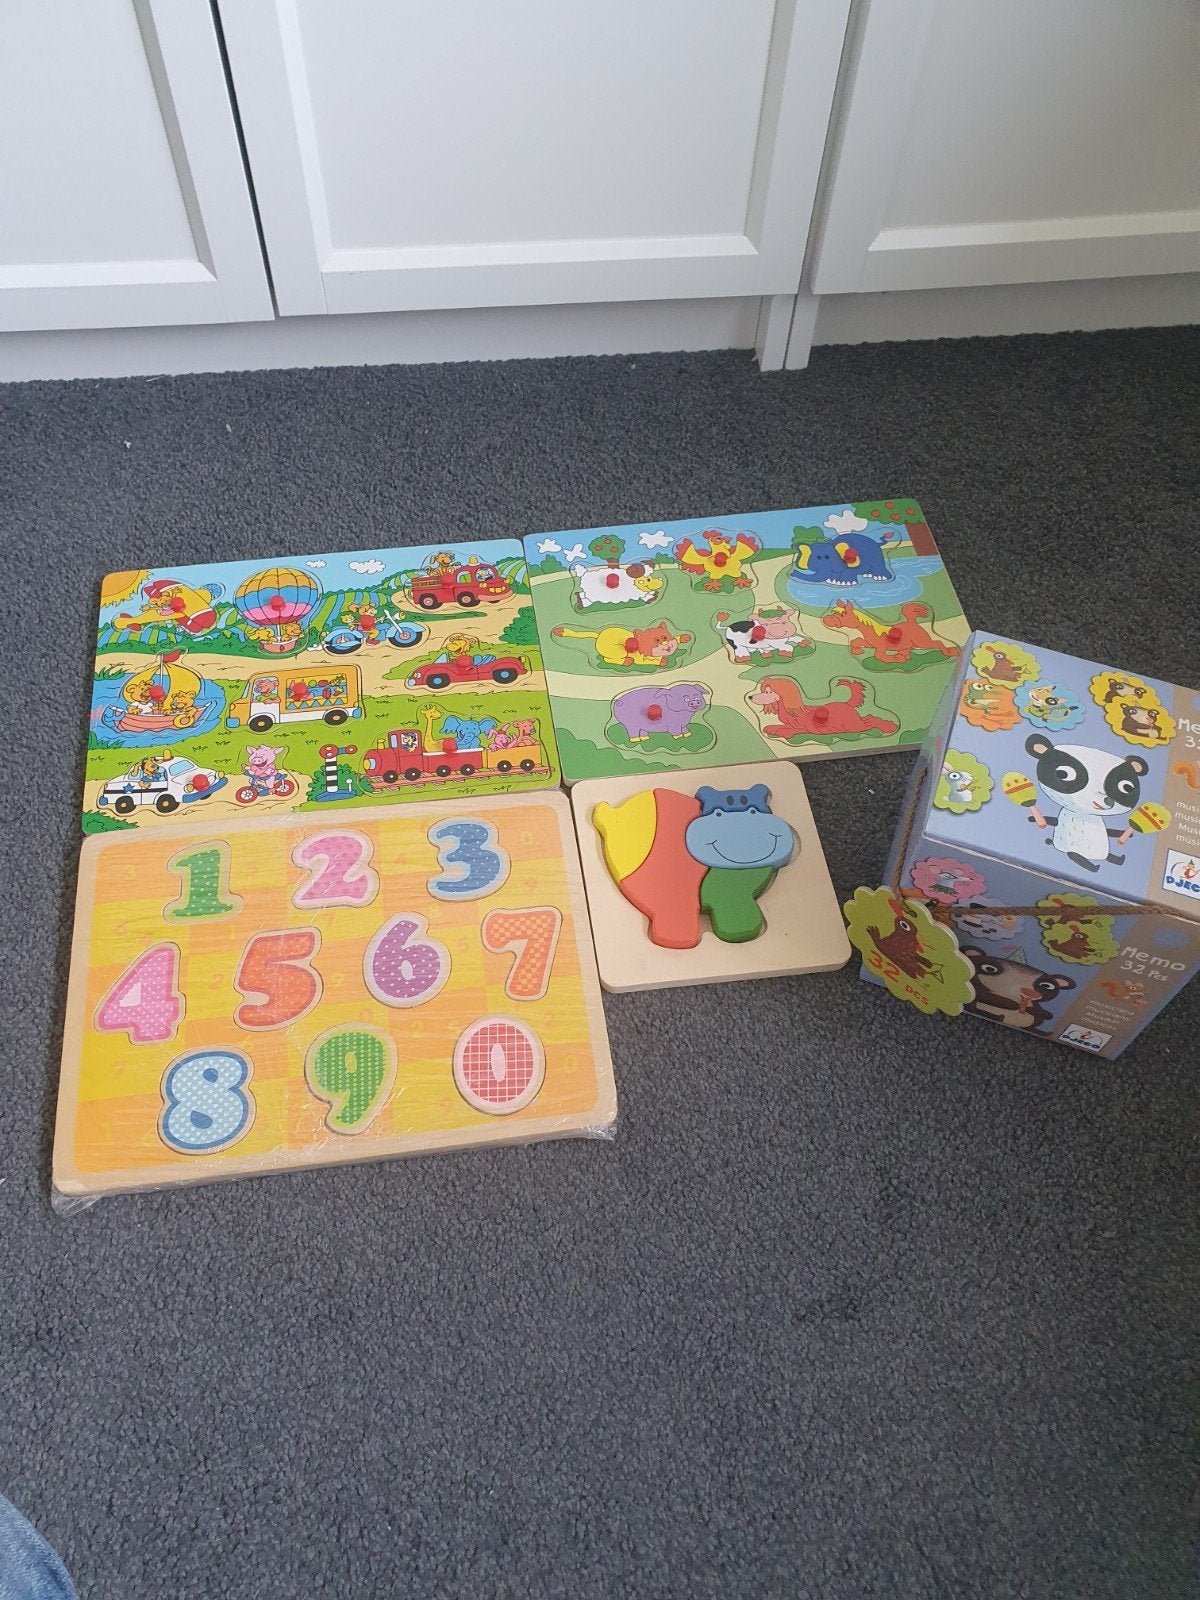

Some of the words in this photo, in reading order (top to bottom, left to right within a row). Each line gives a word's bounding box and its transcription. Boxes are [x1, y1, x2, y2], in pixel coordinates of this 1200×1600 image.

[173, 848, 234, 919] 1
[298, 833, 371, 901] 2
[432, 820, 503, 895] 3
[99, 946, 182, 1042] 4
[237, 930, 319, 1027] 5
[371, 919, 442, 999] 6
[484, 910, 554, 998] 7
[867, 949, 900, 984] 32
[1120, 946, 1186, 971] Memo
[1120, 960, 1146, 975] 32
[162, 1049, 250, 1151] 8
[313, 1031, 386, 1126] 9
[462, 1021, 535, 1104] 0
